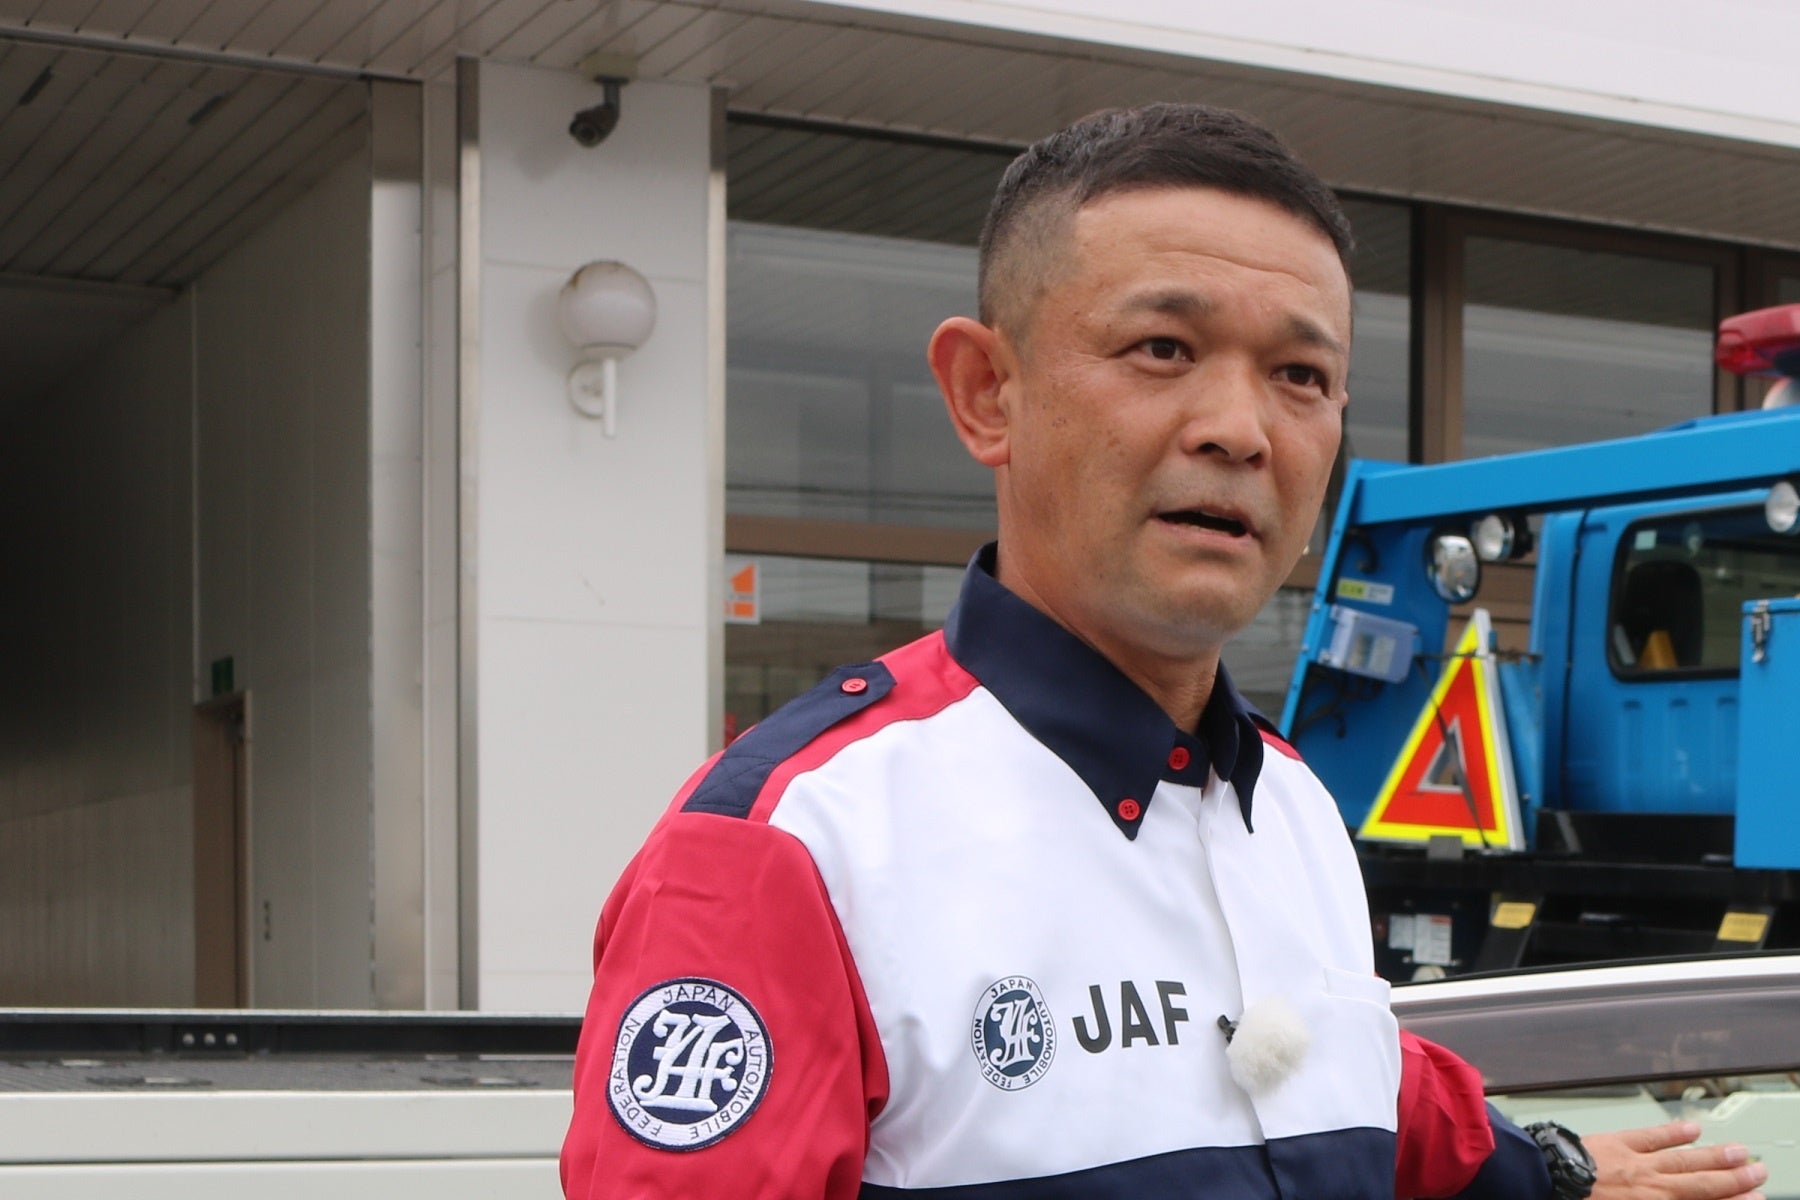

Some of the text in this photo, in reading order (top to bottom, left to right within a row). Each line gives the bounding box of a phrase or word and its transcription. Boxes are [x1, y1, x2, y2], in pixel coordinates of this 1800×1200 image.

[613, 985, 762, 1140] JAPAN AUTOMOBILE FEDERATION
[991, 979, 1033, 998] JAPAN
[1022, 1001, 1054, 1084] AUTOMOBILE
[1072, 980, 1190, 1053] JAF
